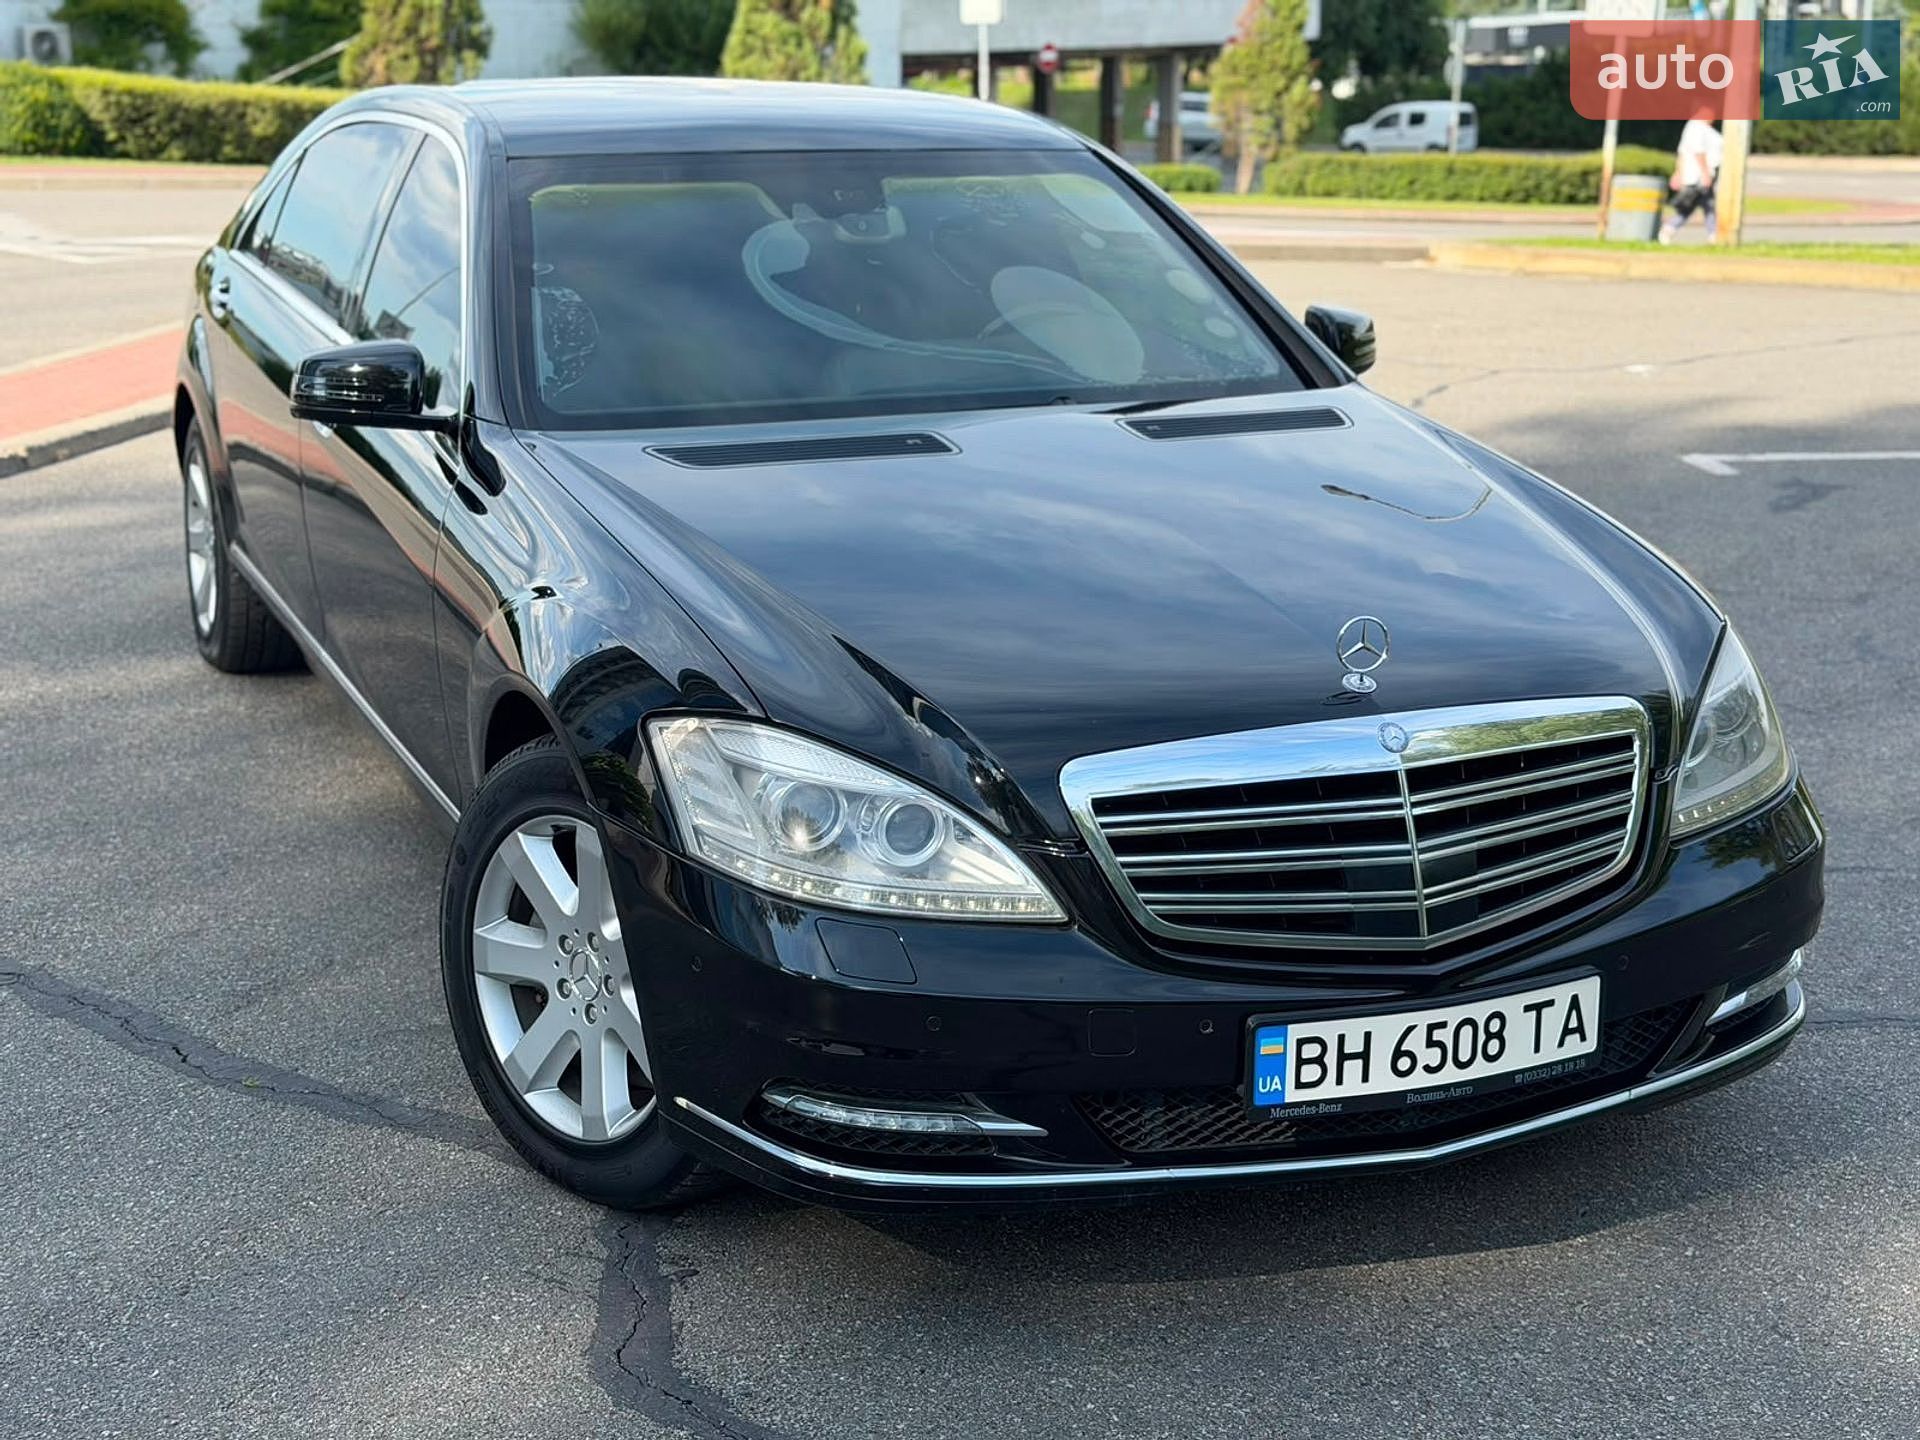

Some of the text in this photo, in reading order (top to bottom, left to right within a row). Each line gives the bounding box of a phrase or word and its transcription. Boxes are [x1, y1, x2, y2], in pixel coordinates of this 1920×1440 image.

[1294, 993, 1587, 1091] BH 6508 TA
[1258, 1074, 1283, 1093] UA
[1269, 1102, 1343, 1119] Mercedes-Benz
